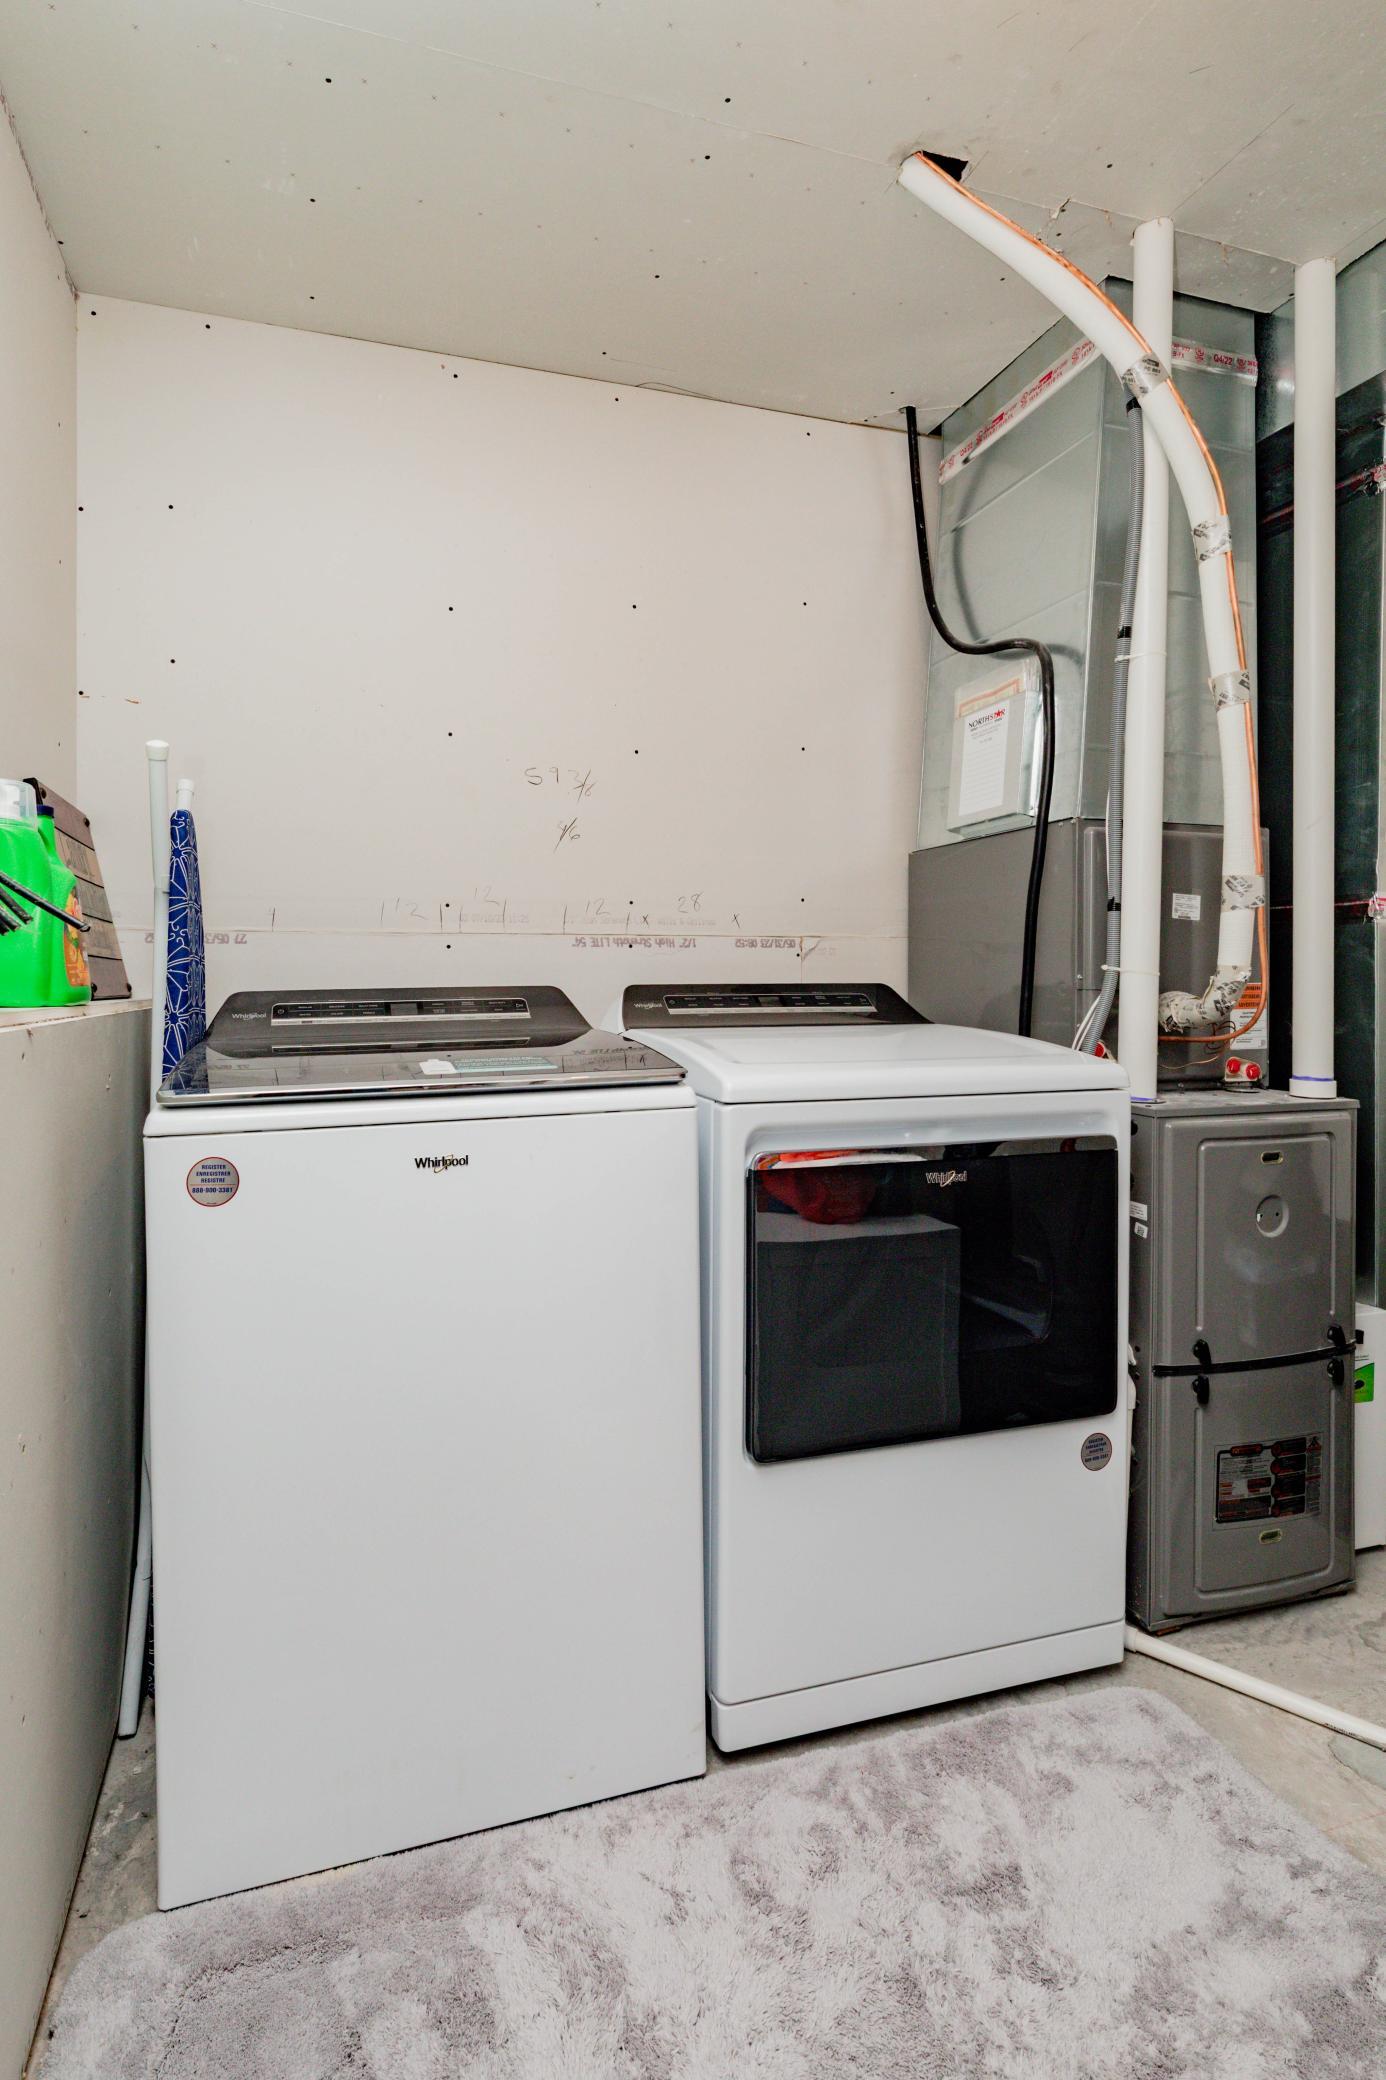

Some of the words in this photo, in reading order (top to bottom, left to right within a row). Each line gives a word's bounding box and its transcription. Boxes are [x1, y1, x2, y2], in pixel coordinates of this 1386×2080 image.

[591, 937, 611, 948] LITE
[232, 1011, 267, 1020] Whirlpool
[414, 1154, 469, 1173] Whirlpool
[925, 1170, 968, 1187] Whirlpool
